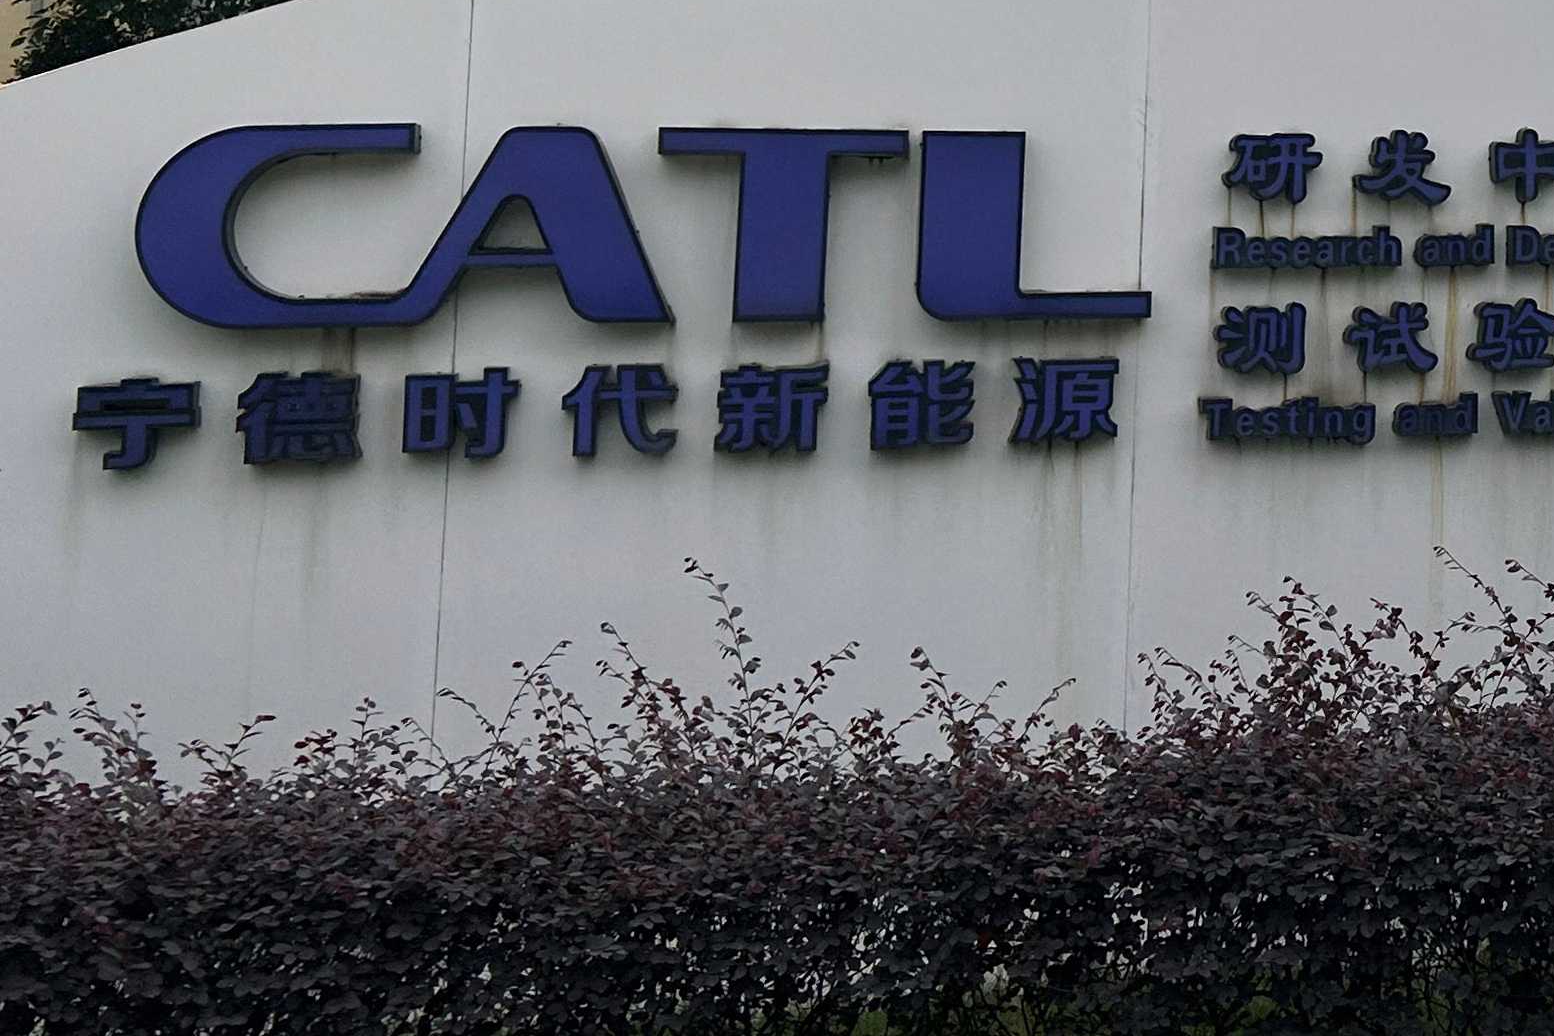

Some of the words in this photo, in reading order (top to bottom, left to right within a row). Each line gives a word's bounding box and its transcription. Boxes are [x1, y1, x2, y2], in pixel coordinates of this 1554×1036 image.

[135, 123, 1151, 329] CATL
[1213, 226, 1402, 267] Research
[1413, 223, 1494, 266] and
[73, 357, 1120, 471] 宁德时代新能源
[1199, 396, 1376, 444] Testing
[1392, 392, 1478, 435] and
